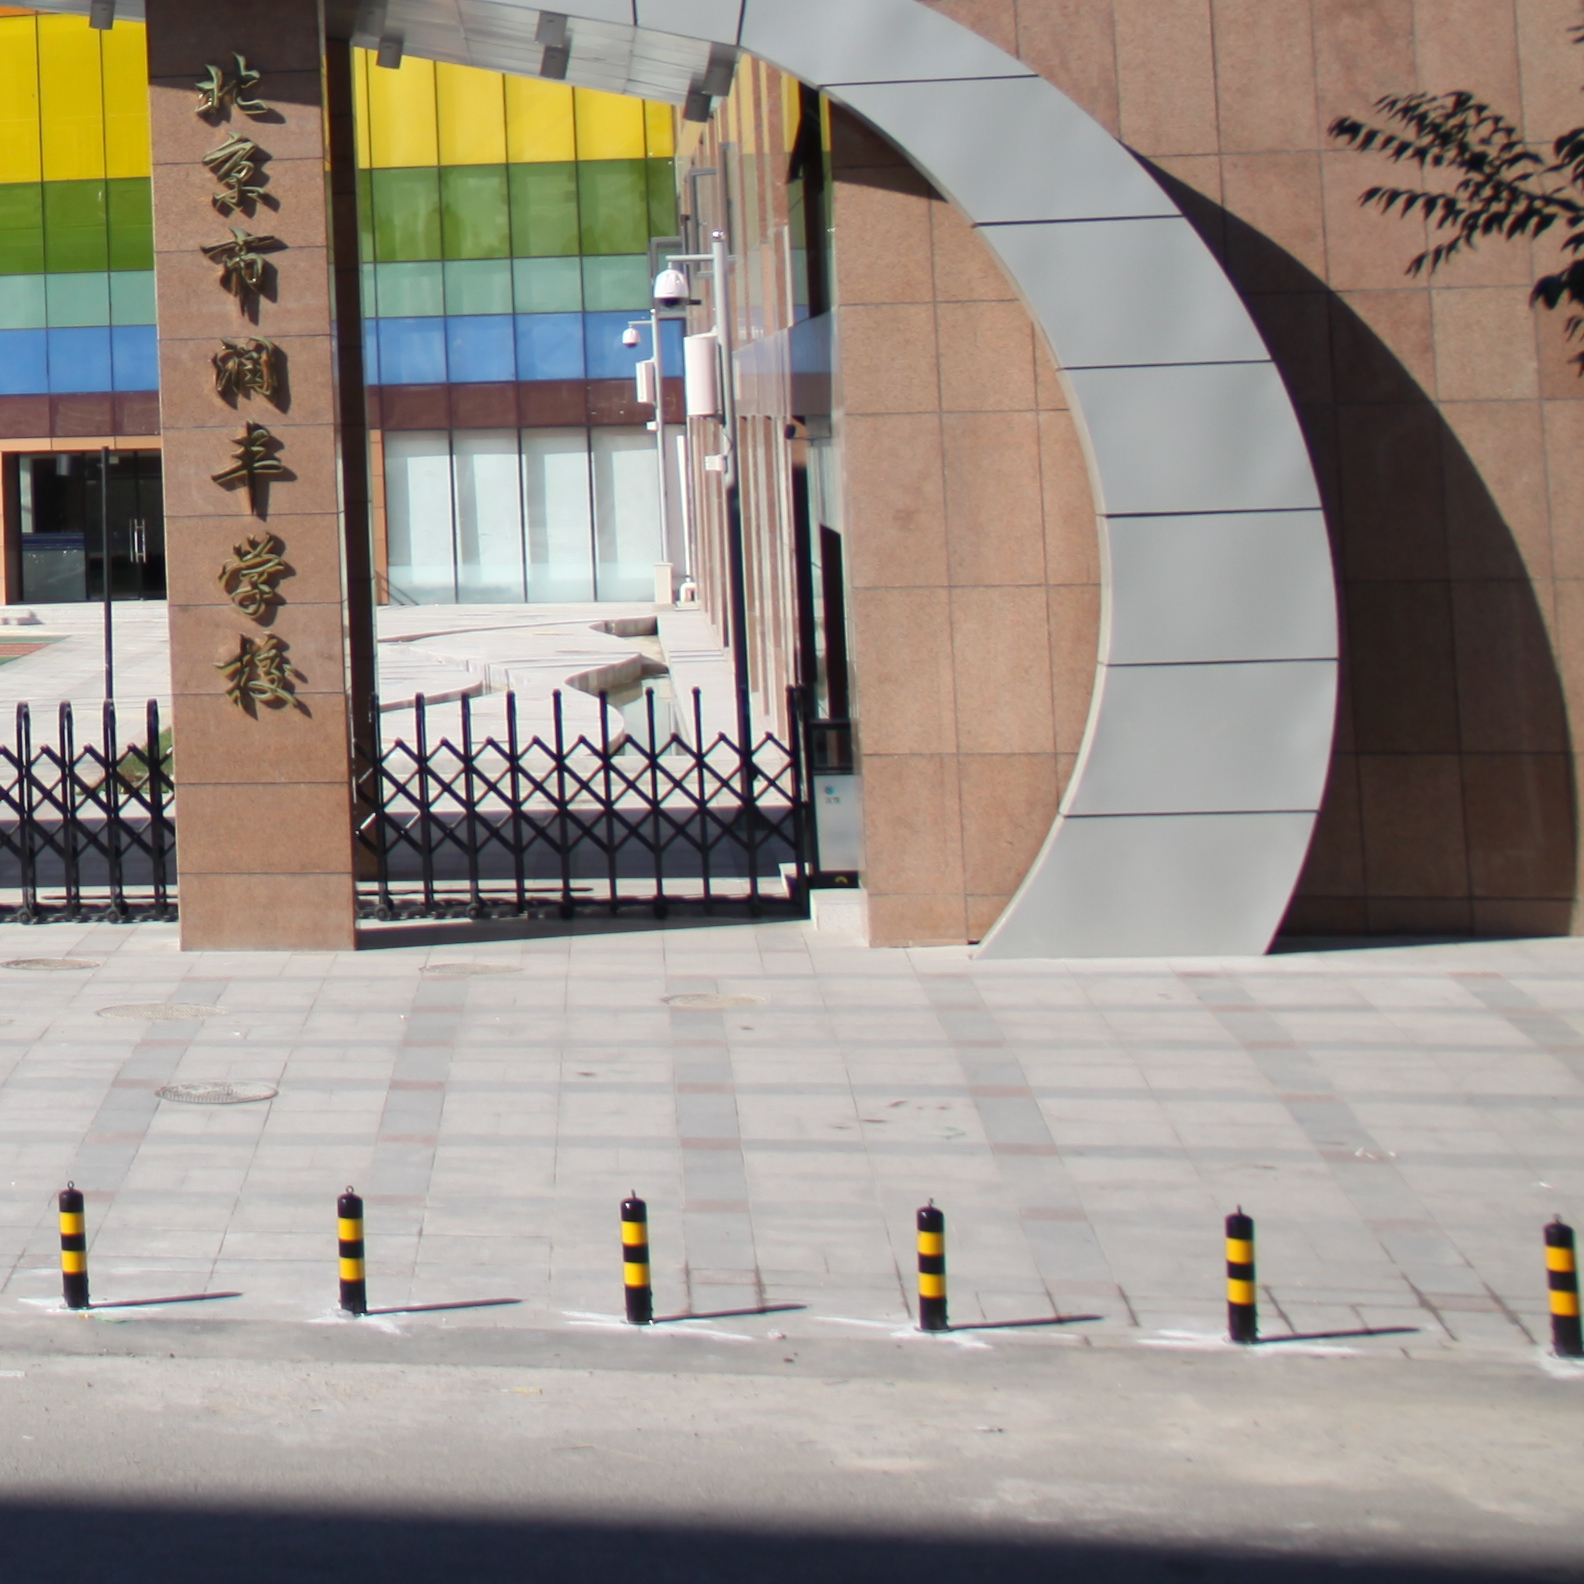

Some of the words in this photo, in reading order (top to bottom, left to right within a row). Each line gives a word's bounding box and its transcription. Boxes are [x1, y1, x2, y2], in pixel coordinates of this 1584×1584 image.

[194, 51, 301, 713] 北京市润丰学校
